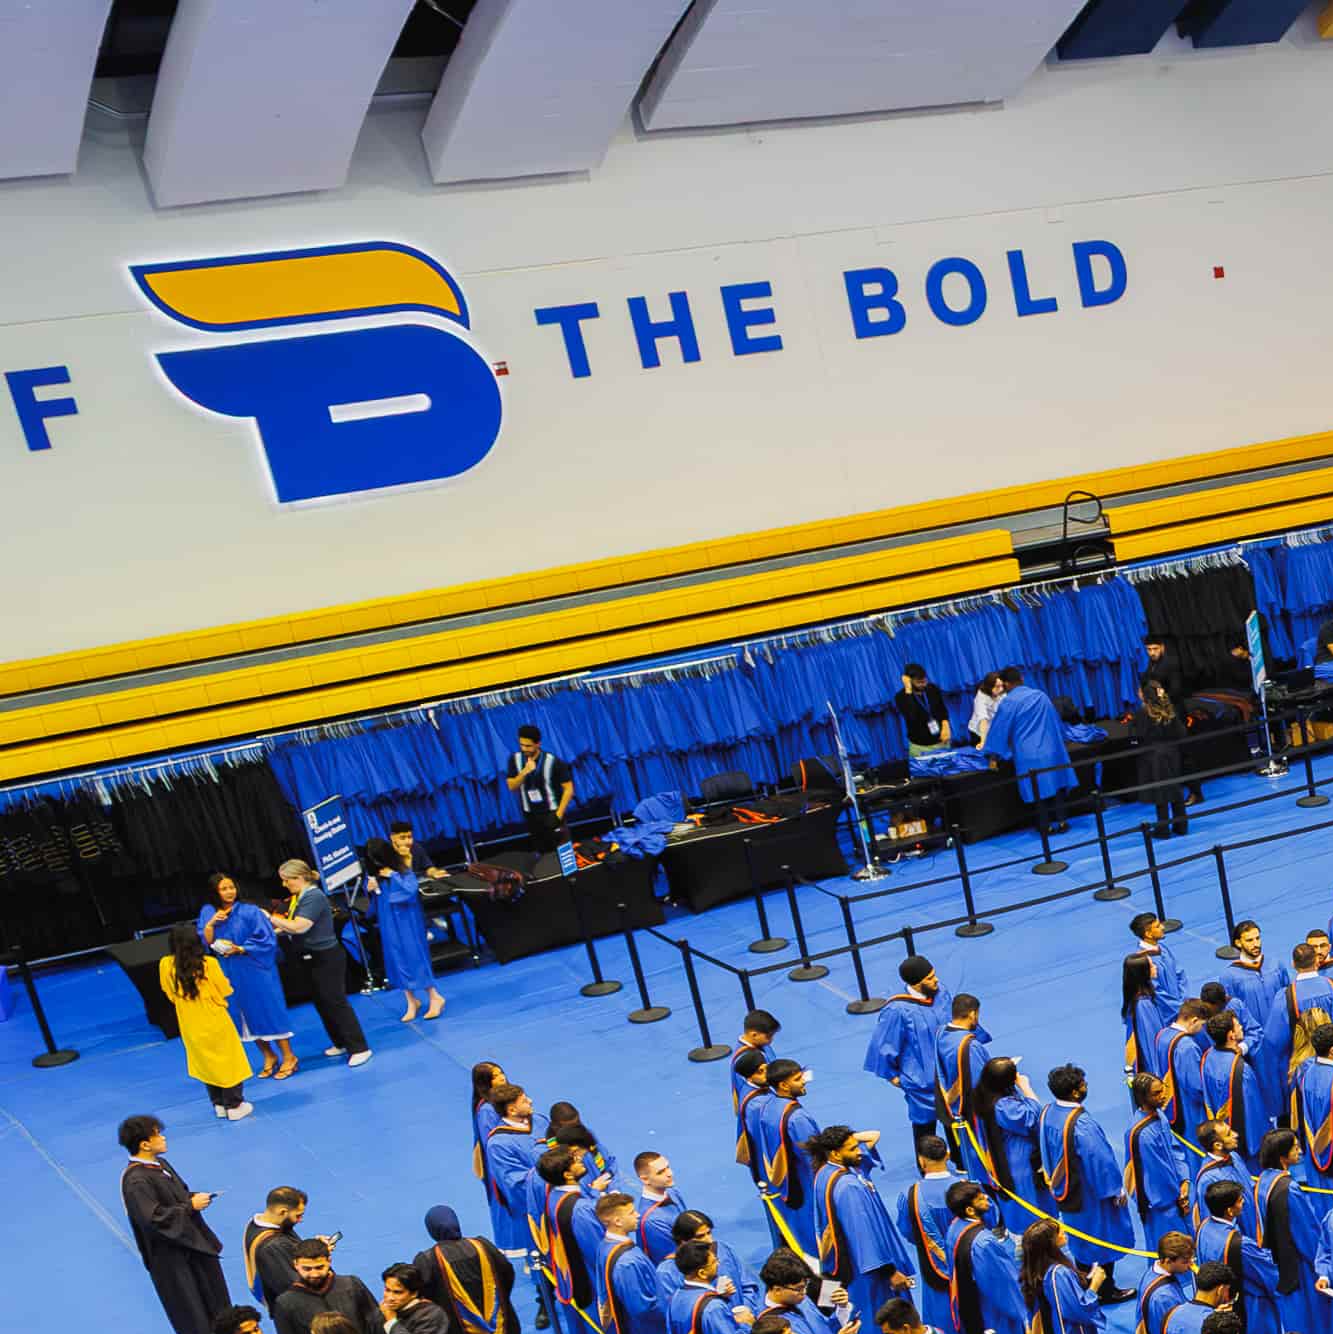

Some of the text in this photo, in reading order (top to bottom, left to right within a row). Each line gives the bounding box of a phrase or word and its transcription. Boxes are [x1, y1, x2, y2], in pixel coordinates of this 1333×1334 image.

[6, 366, 78, 451] F
[535, 281, 783, 378] THE
[844, 240, 1127, 339] BOLD
